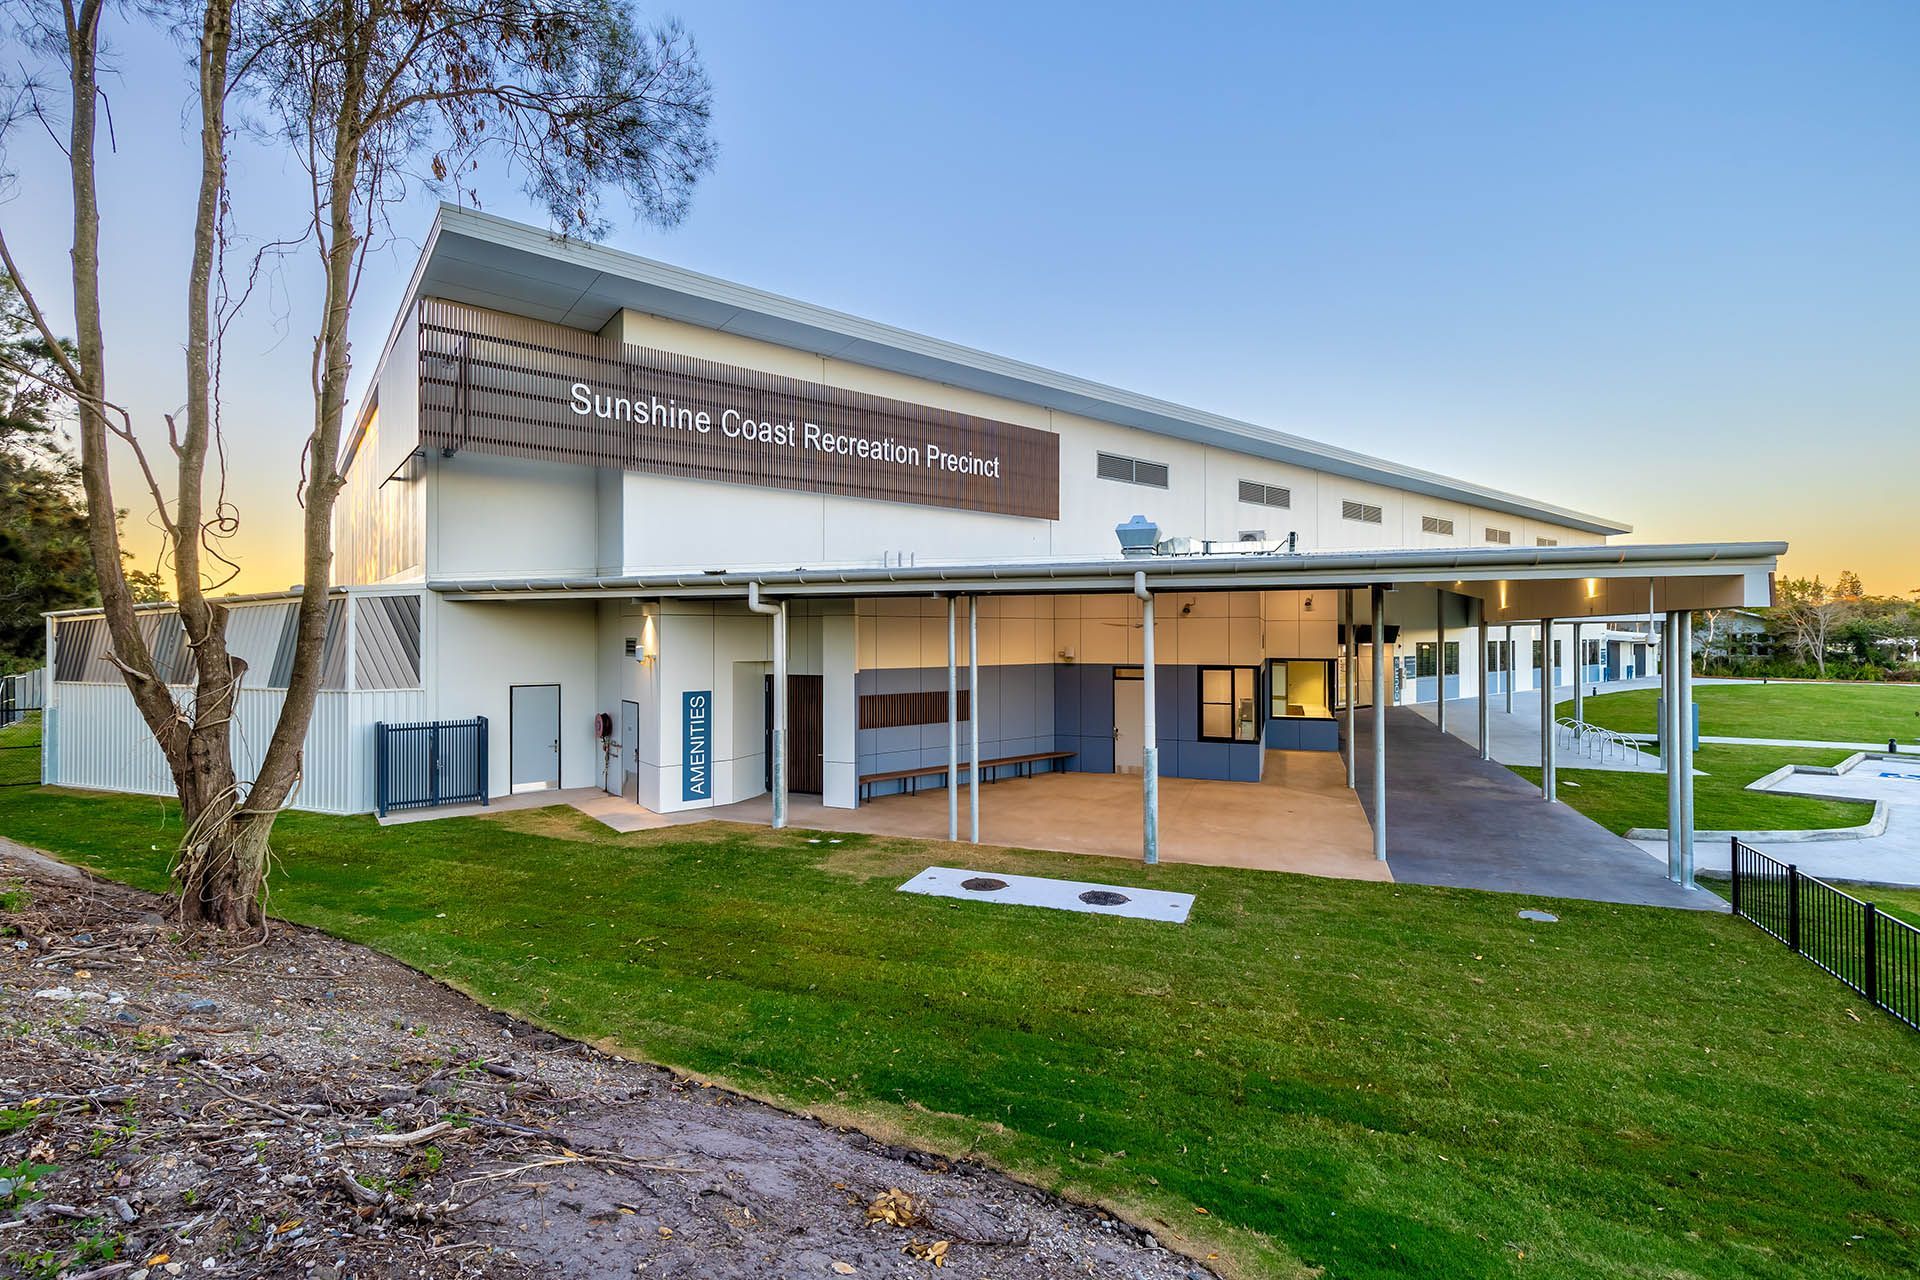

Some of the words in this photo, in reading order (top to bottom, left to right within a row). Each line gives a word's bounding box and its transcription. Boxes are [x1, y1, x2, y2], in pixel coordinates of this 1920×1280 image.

[570, 382, 711, 433] Sunshine
[721, 409, 796, 447] Coast
[804, 423, 919, 466] Recreation
[927, 444, 1000, 478] Precinct
[690, 695, 705, 794] AMENITIES
